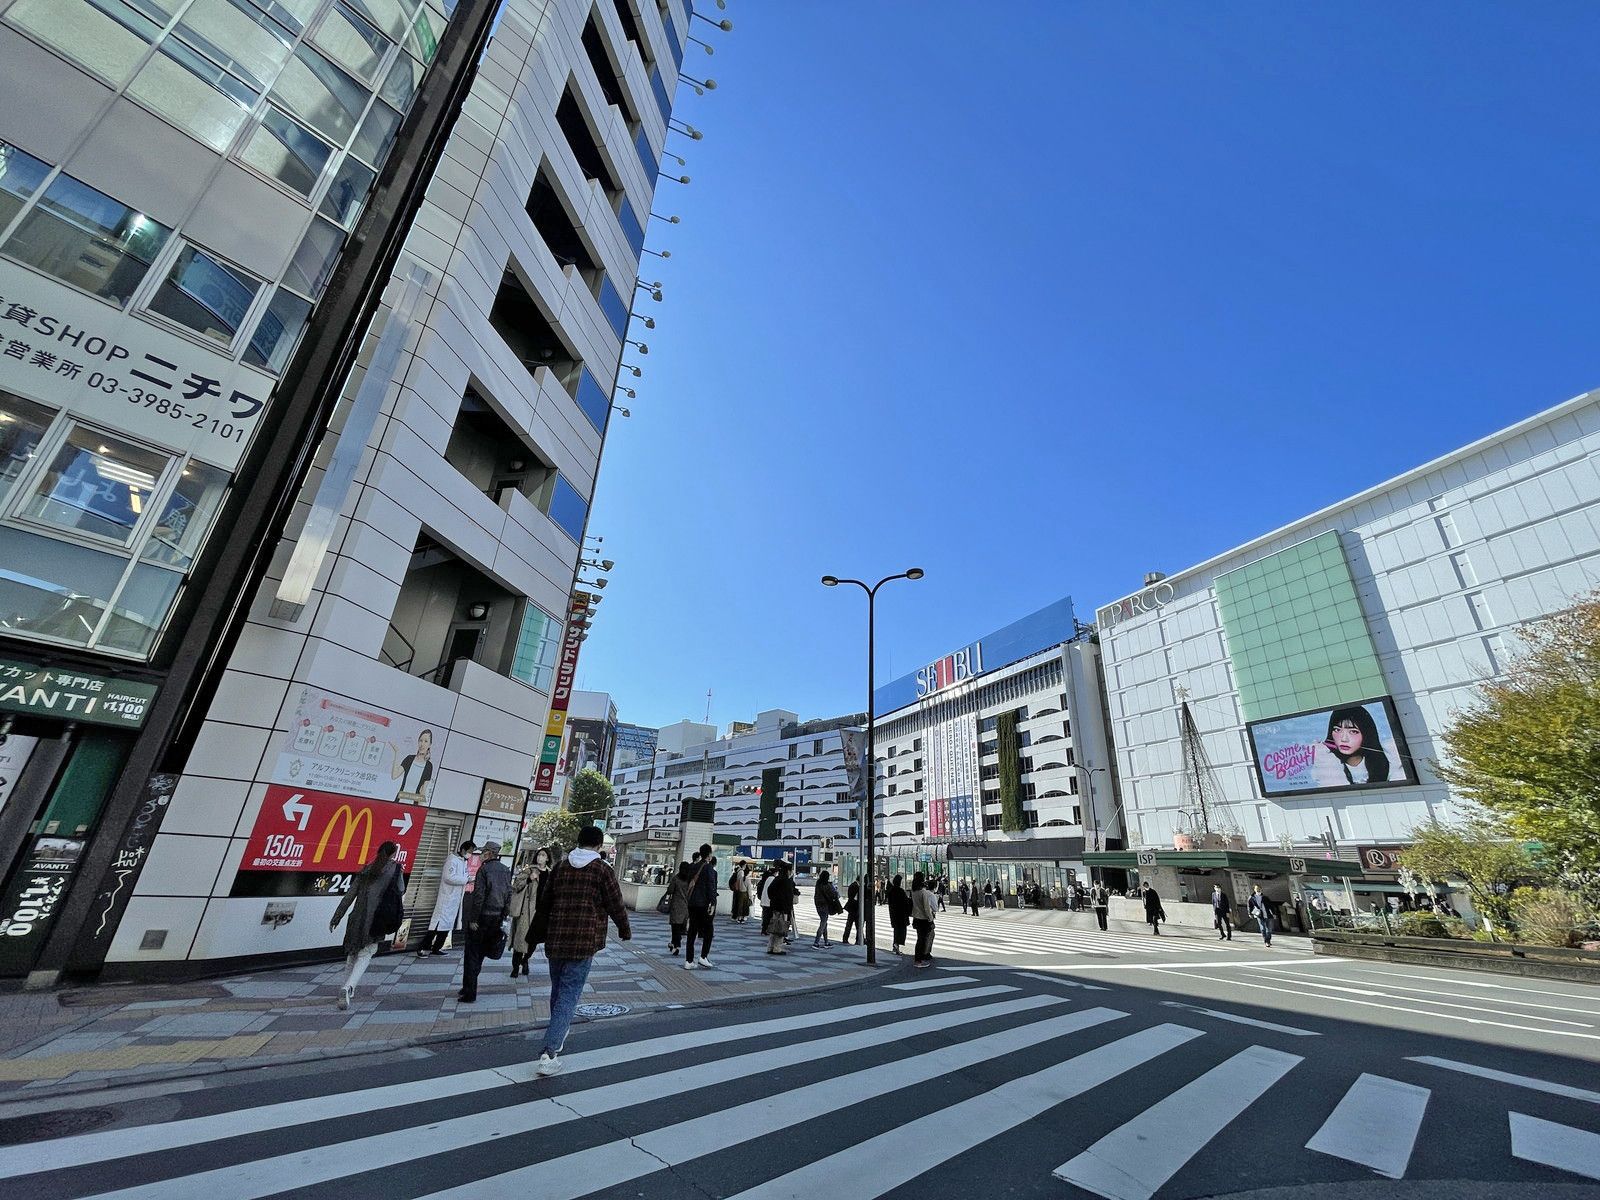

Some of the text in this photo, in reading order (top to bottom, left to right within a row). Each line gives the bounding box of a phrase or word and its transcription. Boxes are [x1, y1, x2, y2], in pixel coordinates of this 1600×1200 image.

[0, 296, 130, 362] 貸SHOP
[130, 353, 264, 419] ニチワ
[0, 334, 245, 443] 営業所 03-3985-2101
[1111, 583, 1174, 625] PARCO
[555, 626, 581, 700] サンドラッグ
[917, 642, 984, 698] SEIBU
[0, 664, 105, 692] カット専門店
[103, 701, 144, 715] ¥1,100
[107, 693, 148, 705] HAIRCUT
[1264, 743, 1301, 772] Cosme
[1275, 745, 1315, 780] Beauty
[264, 834, 304, 857] 150m
[1140, 854, 1154, 865] ISP
[1291, 859, 1305, 871] ISP
